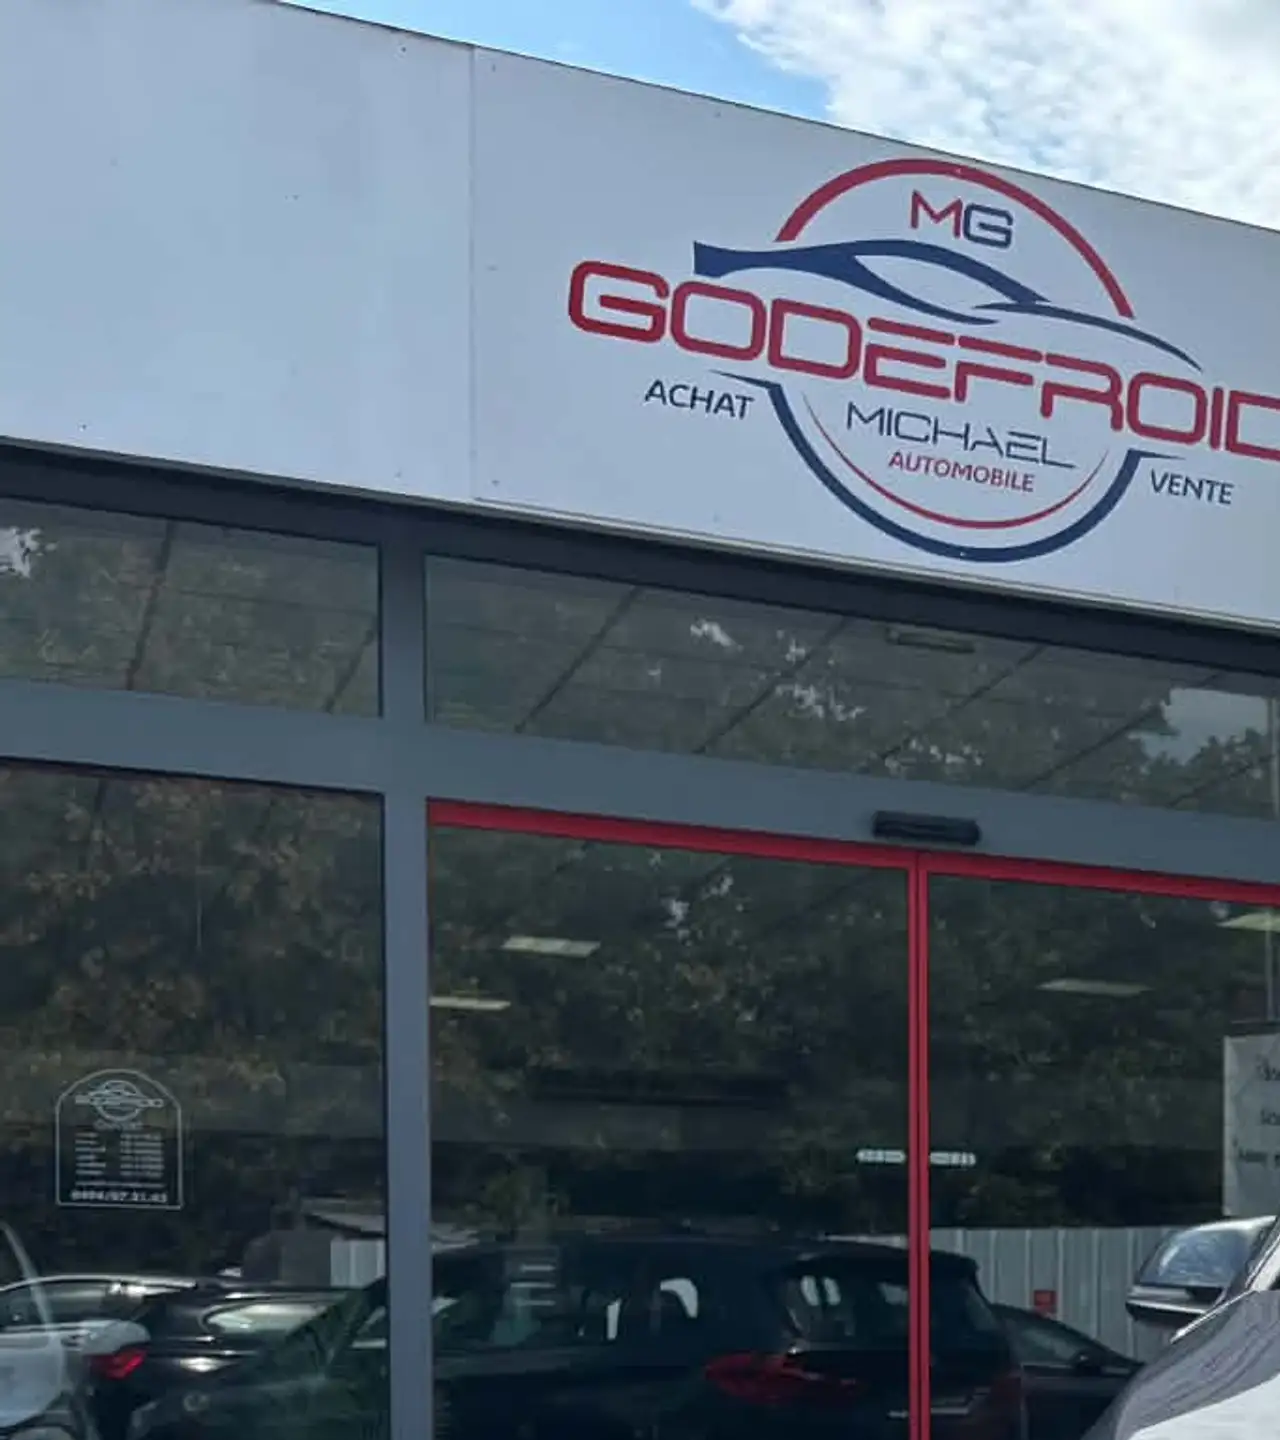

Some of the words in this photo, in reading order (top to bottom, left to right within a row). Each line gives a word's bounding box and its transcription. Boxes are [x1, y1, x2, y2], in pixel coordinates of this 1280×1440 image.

[910, 191, 1013, 248] MG
[644, 379, 754, 419] ACHAT
[847, 401, 1076, 469] MICHAEL
[888, 452, 1035, 493] AUTOMOBILE
[1150, 469, 1234, 505] VENTE
